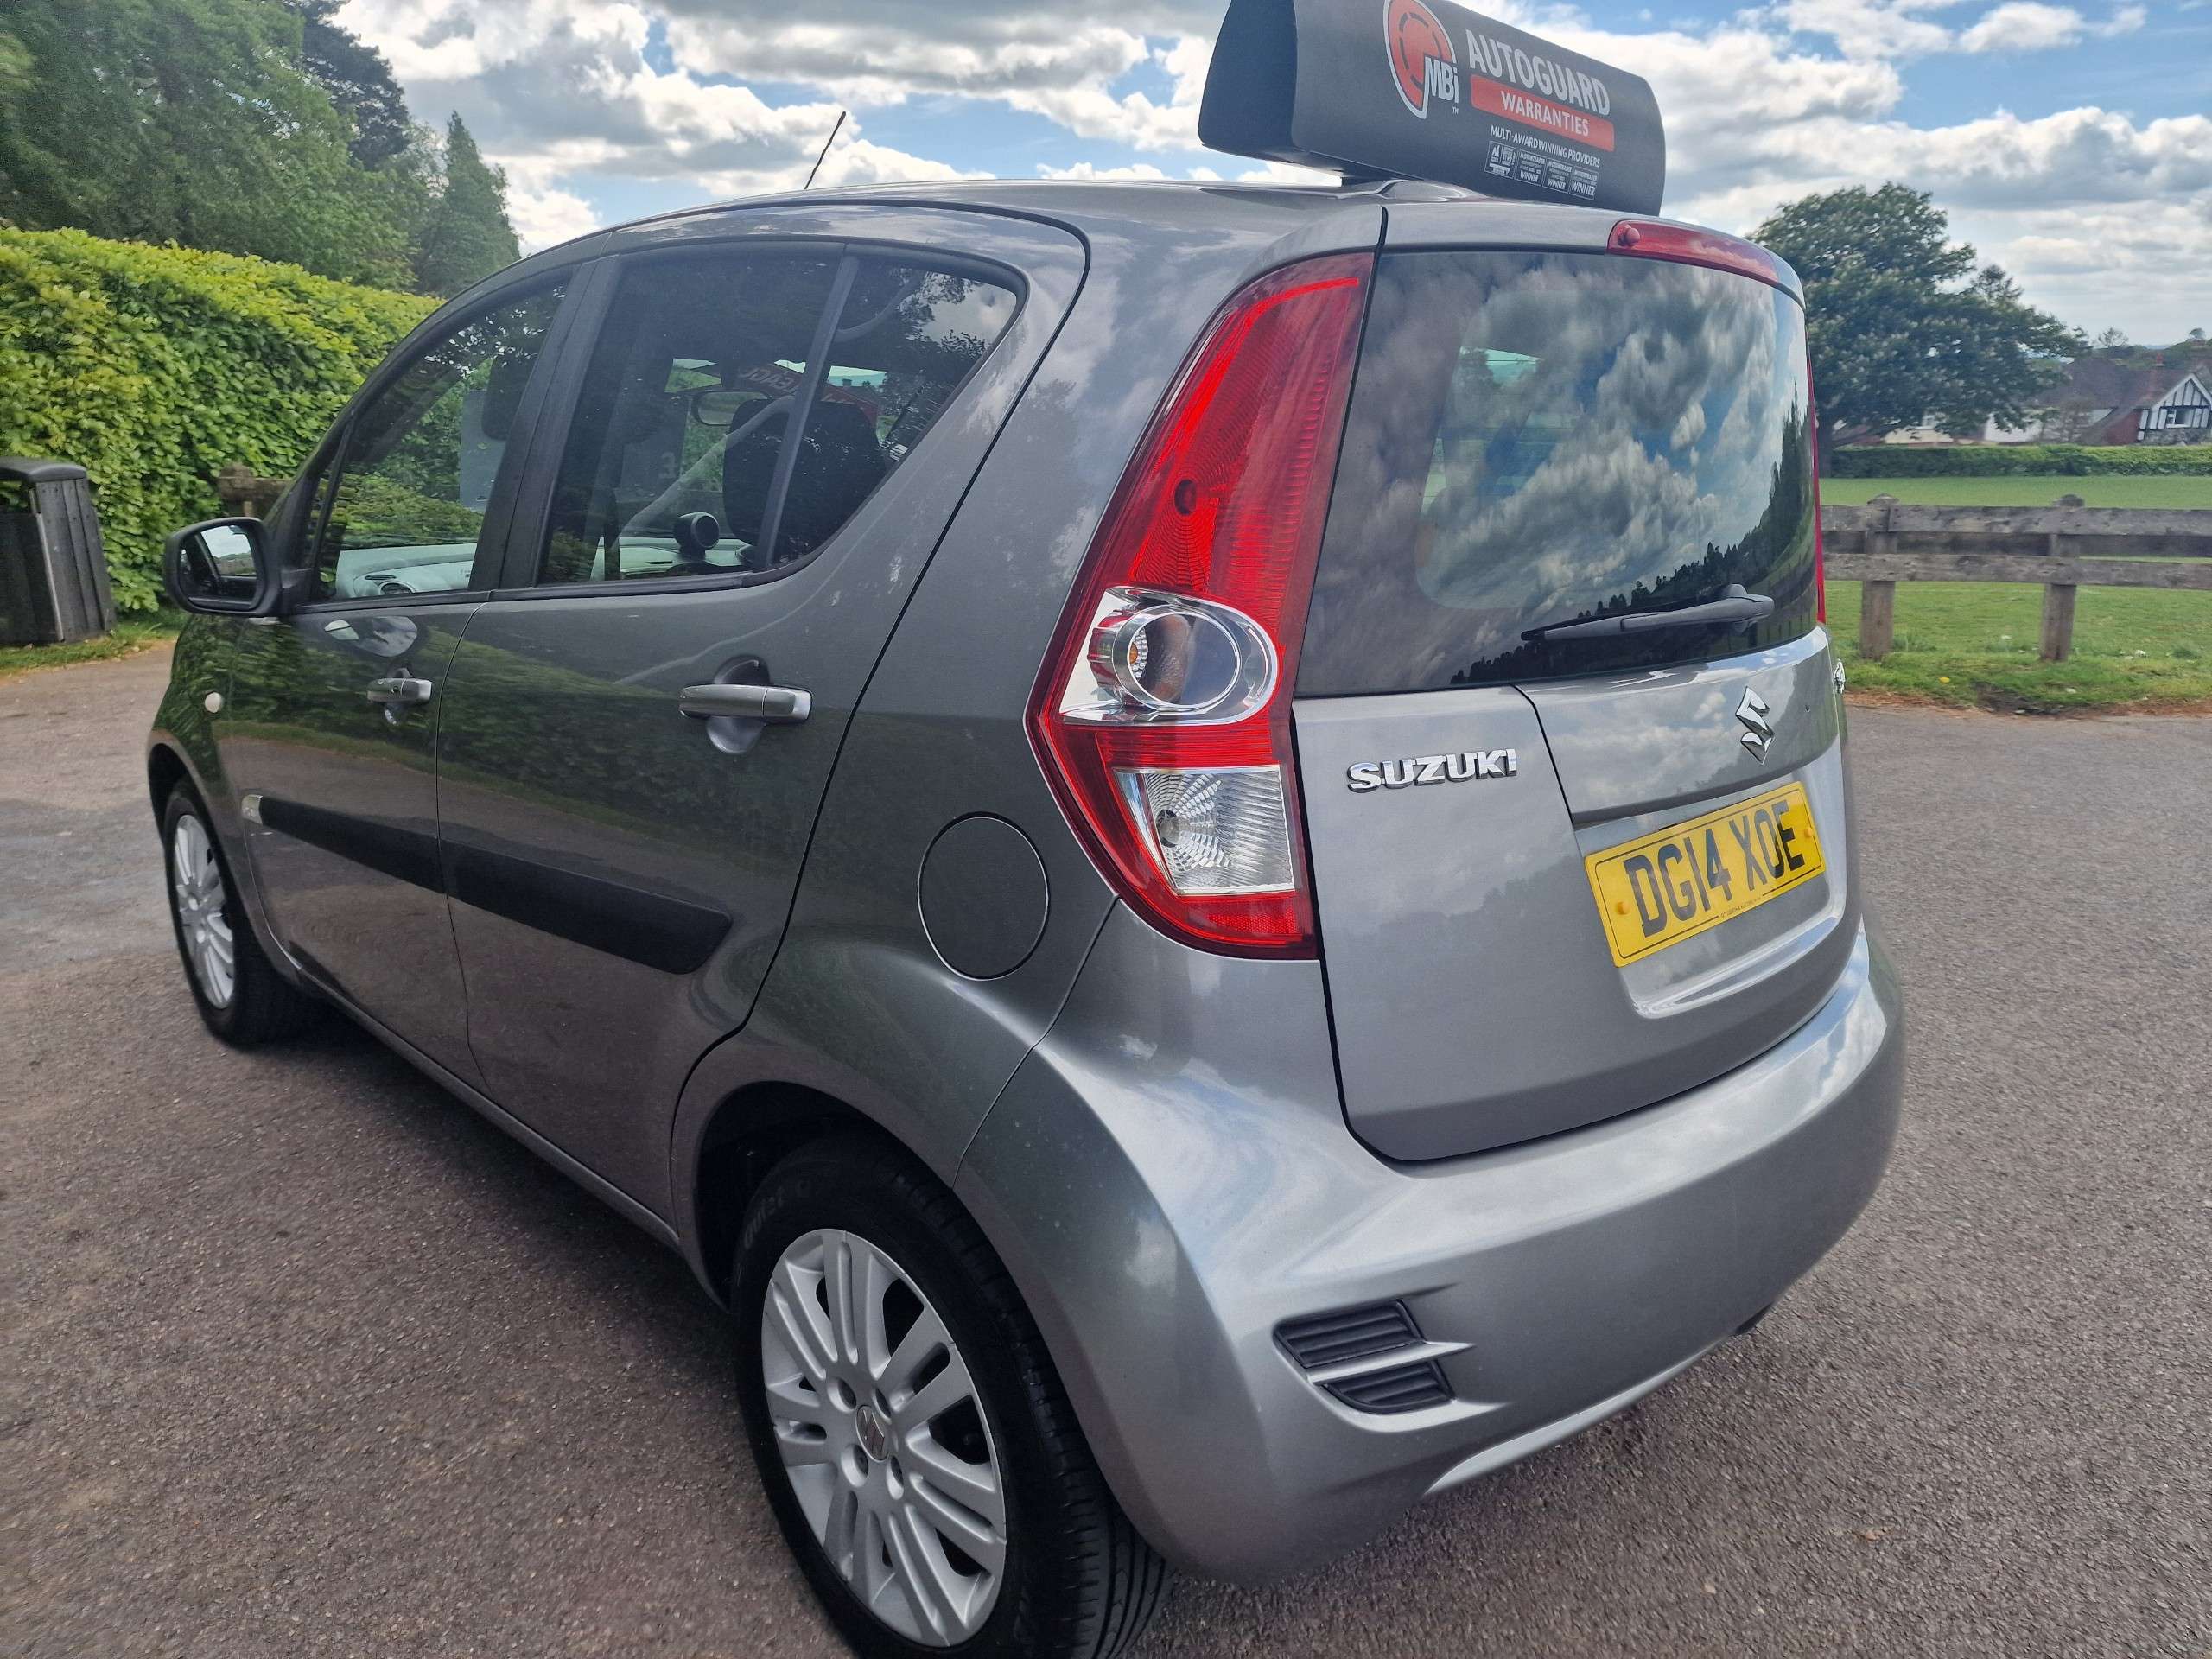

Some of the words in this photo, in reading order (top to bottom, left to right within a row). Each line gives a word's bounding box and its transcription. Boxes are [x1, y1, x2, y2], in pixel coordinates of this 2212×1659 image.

[1465, 29, 1611, 116] AUTOGUARD
[1501, 91, 1590, 137] WARRANTIES
[1491, 124, 1538, 149] MULTI-AWARD
[1538, 141, 1567, 158] WINNING
[1567, 148, 1600, 168] PROVIDERS
[1521, 170, 1539, 182] WINNER
[1548, 178, 1566, 189] WINNER
[1572, 181, 1596, 196] WINNER
[1347, 748, 1517, 793] SUZUKI
[1623, 829, 1732, 938] DG14
[1729, 799, 1806, 892] XOE
